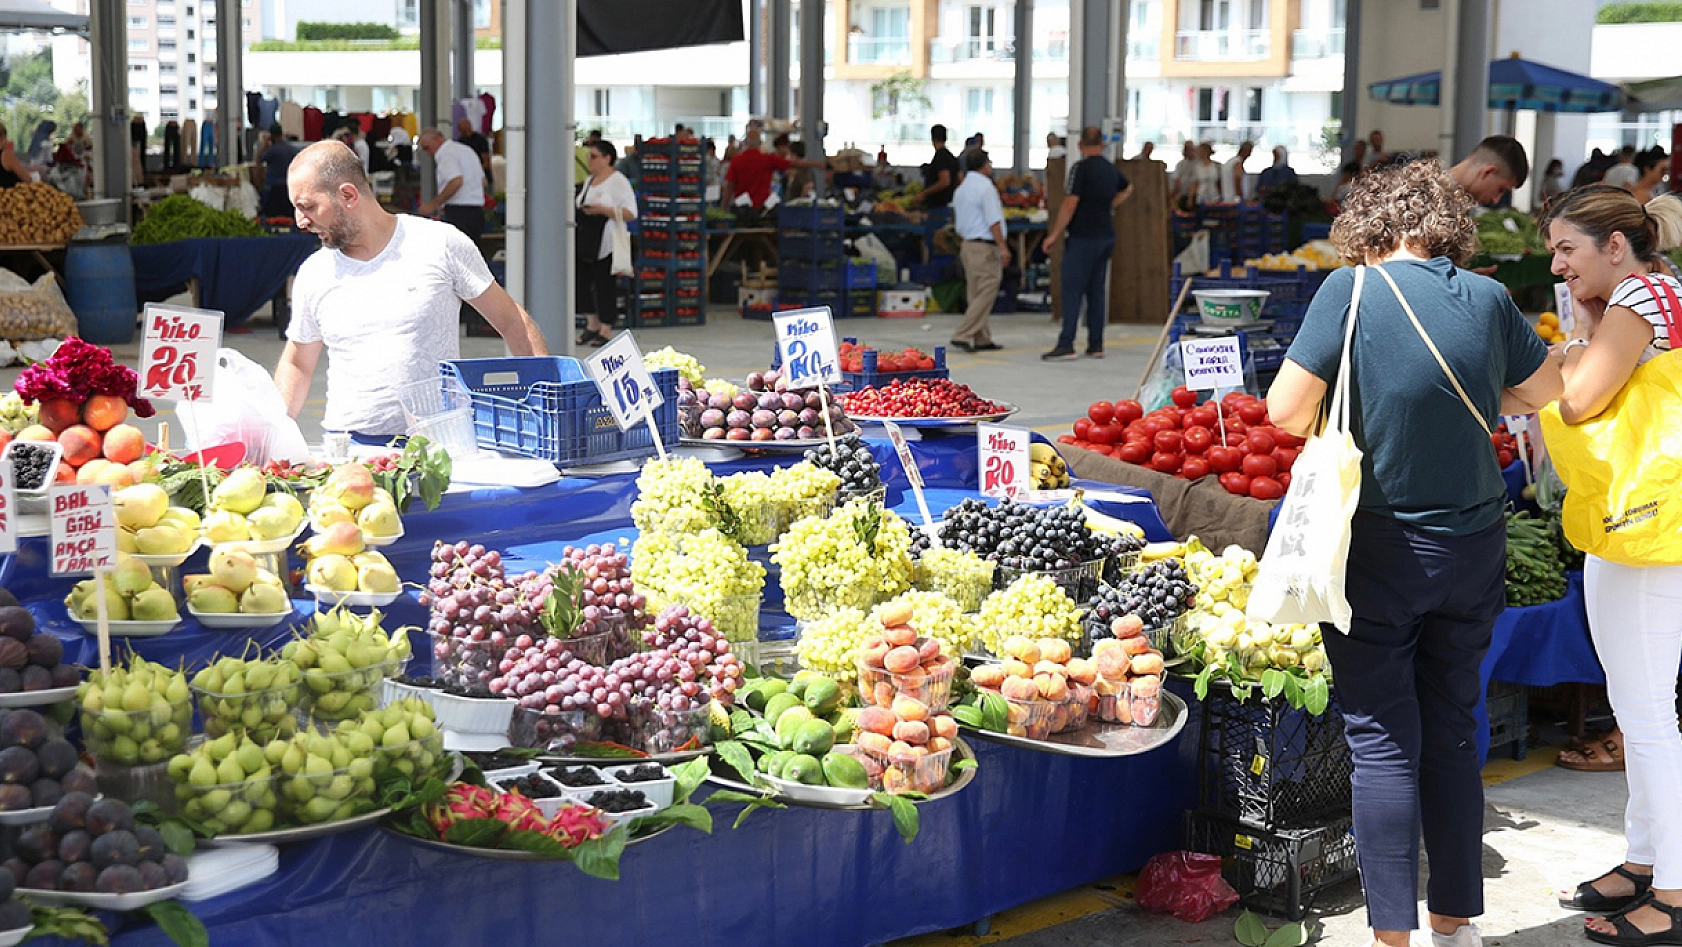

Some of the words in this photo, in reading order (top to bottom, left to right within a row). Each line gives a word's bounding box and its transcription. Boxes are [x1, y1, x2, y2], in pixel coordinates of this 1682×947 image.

[144, 346, 198, 390] 25
[787, 340, 822, 381] 20
[612, 370, 640, 414] 15
[985, 456, 1015, 492] 20
[54, 490, 89, 513] BAL
